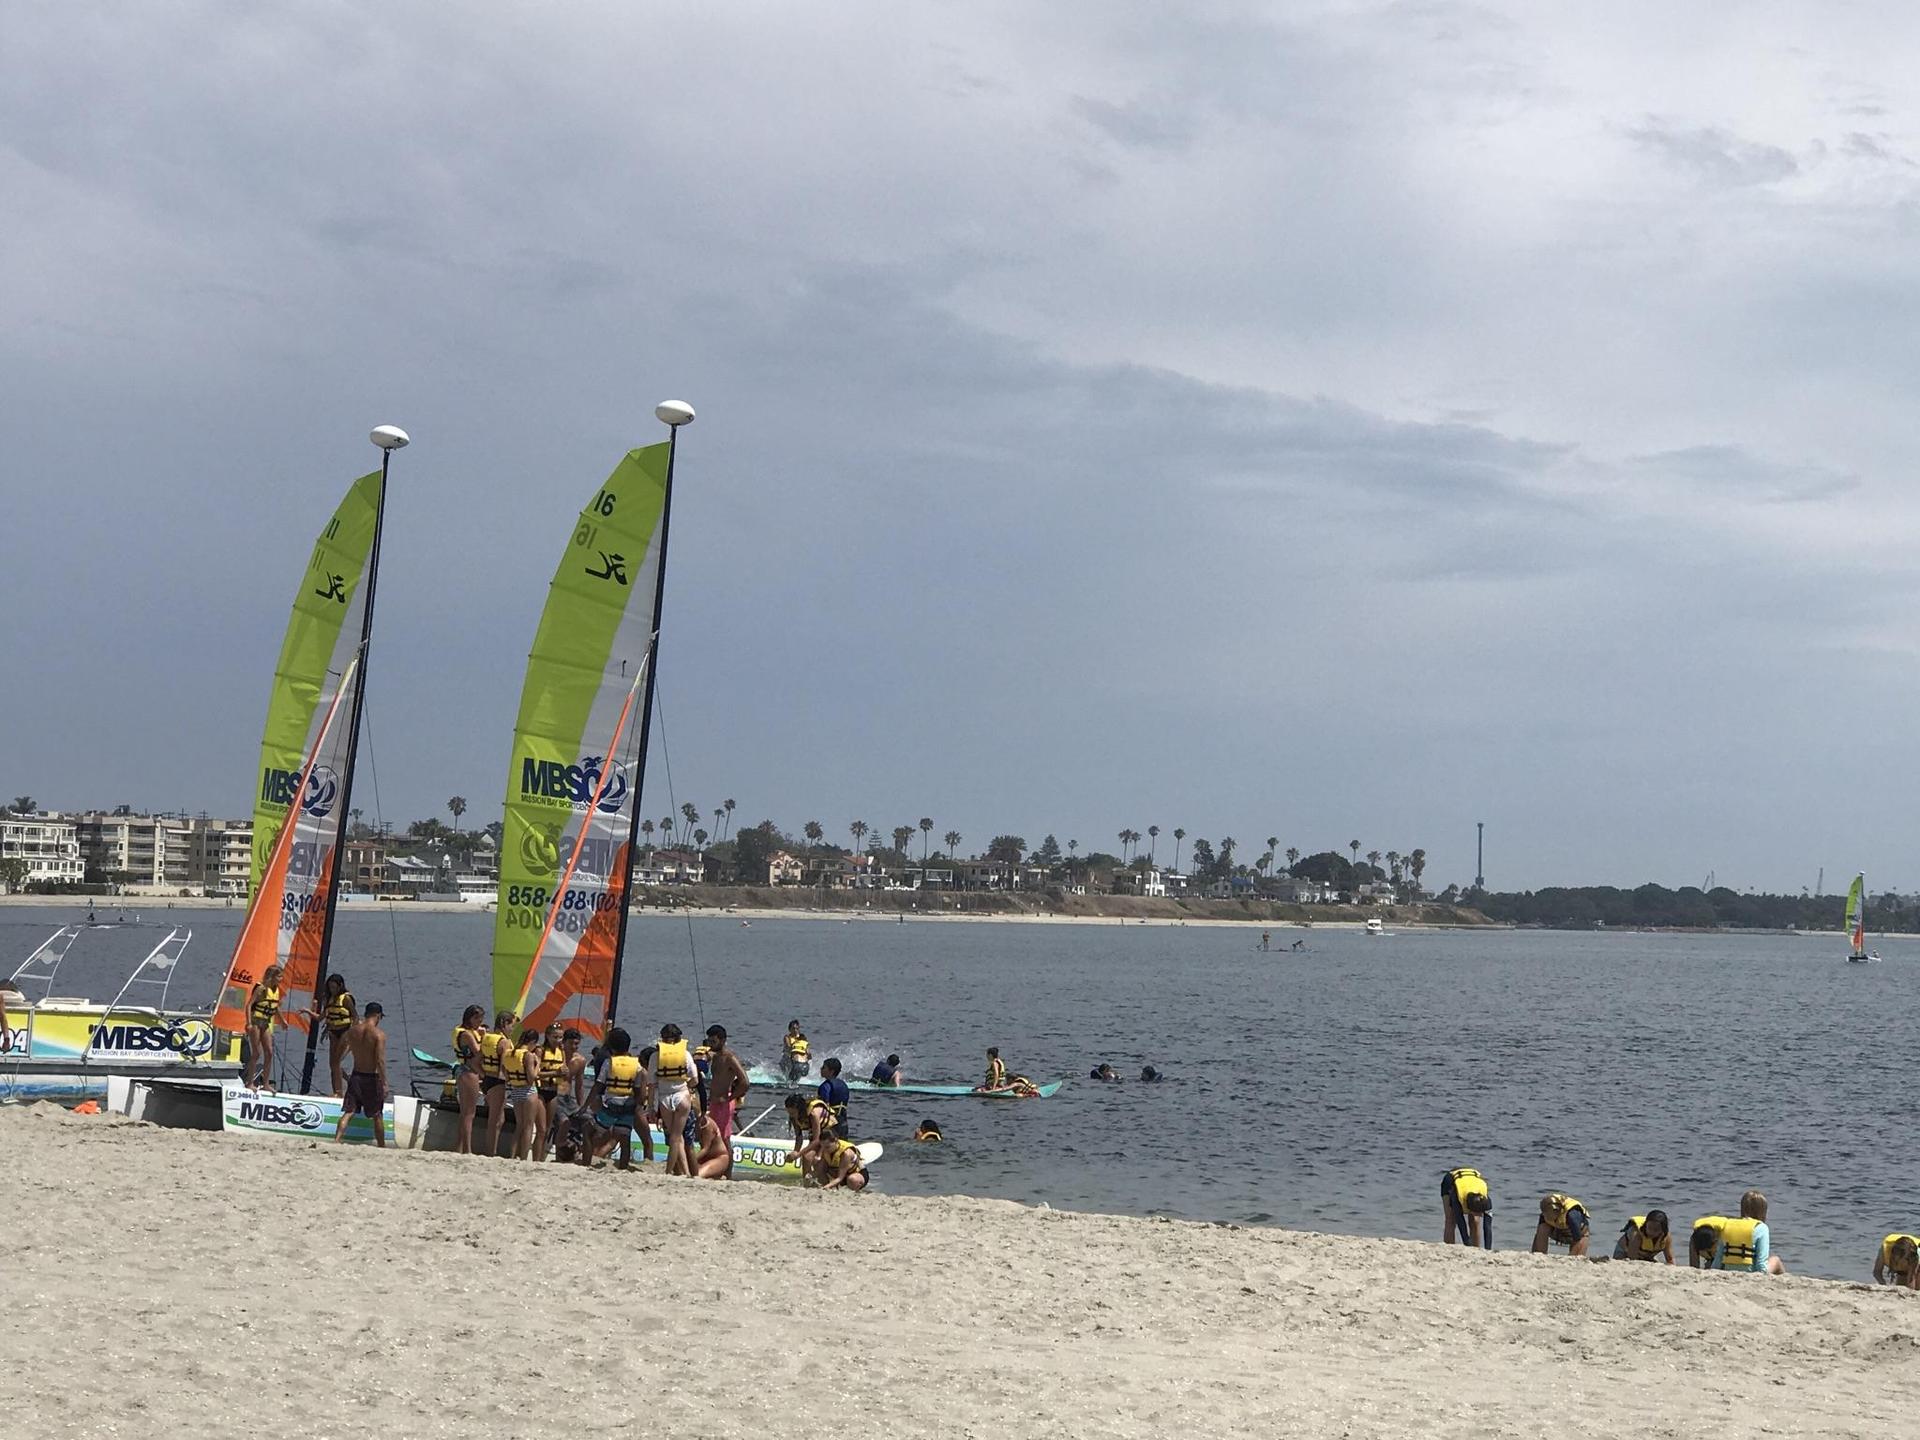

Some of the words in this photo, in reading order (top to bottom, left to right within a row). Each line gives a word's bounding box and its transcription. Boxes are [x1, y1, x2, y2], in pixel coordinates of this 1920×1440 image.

[594, 490, 616, 516] 16
[521, 757, 602, 805] MBSC
[92, 1025, 189, 1052] MBSC
[240, 1102, 307, 1126] MBSC
